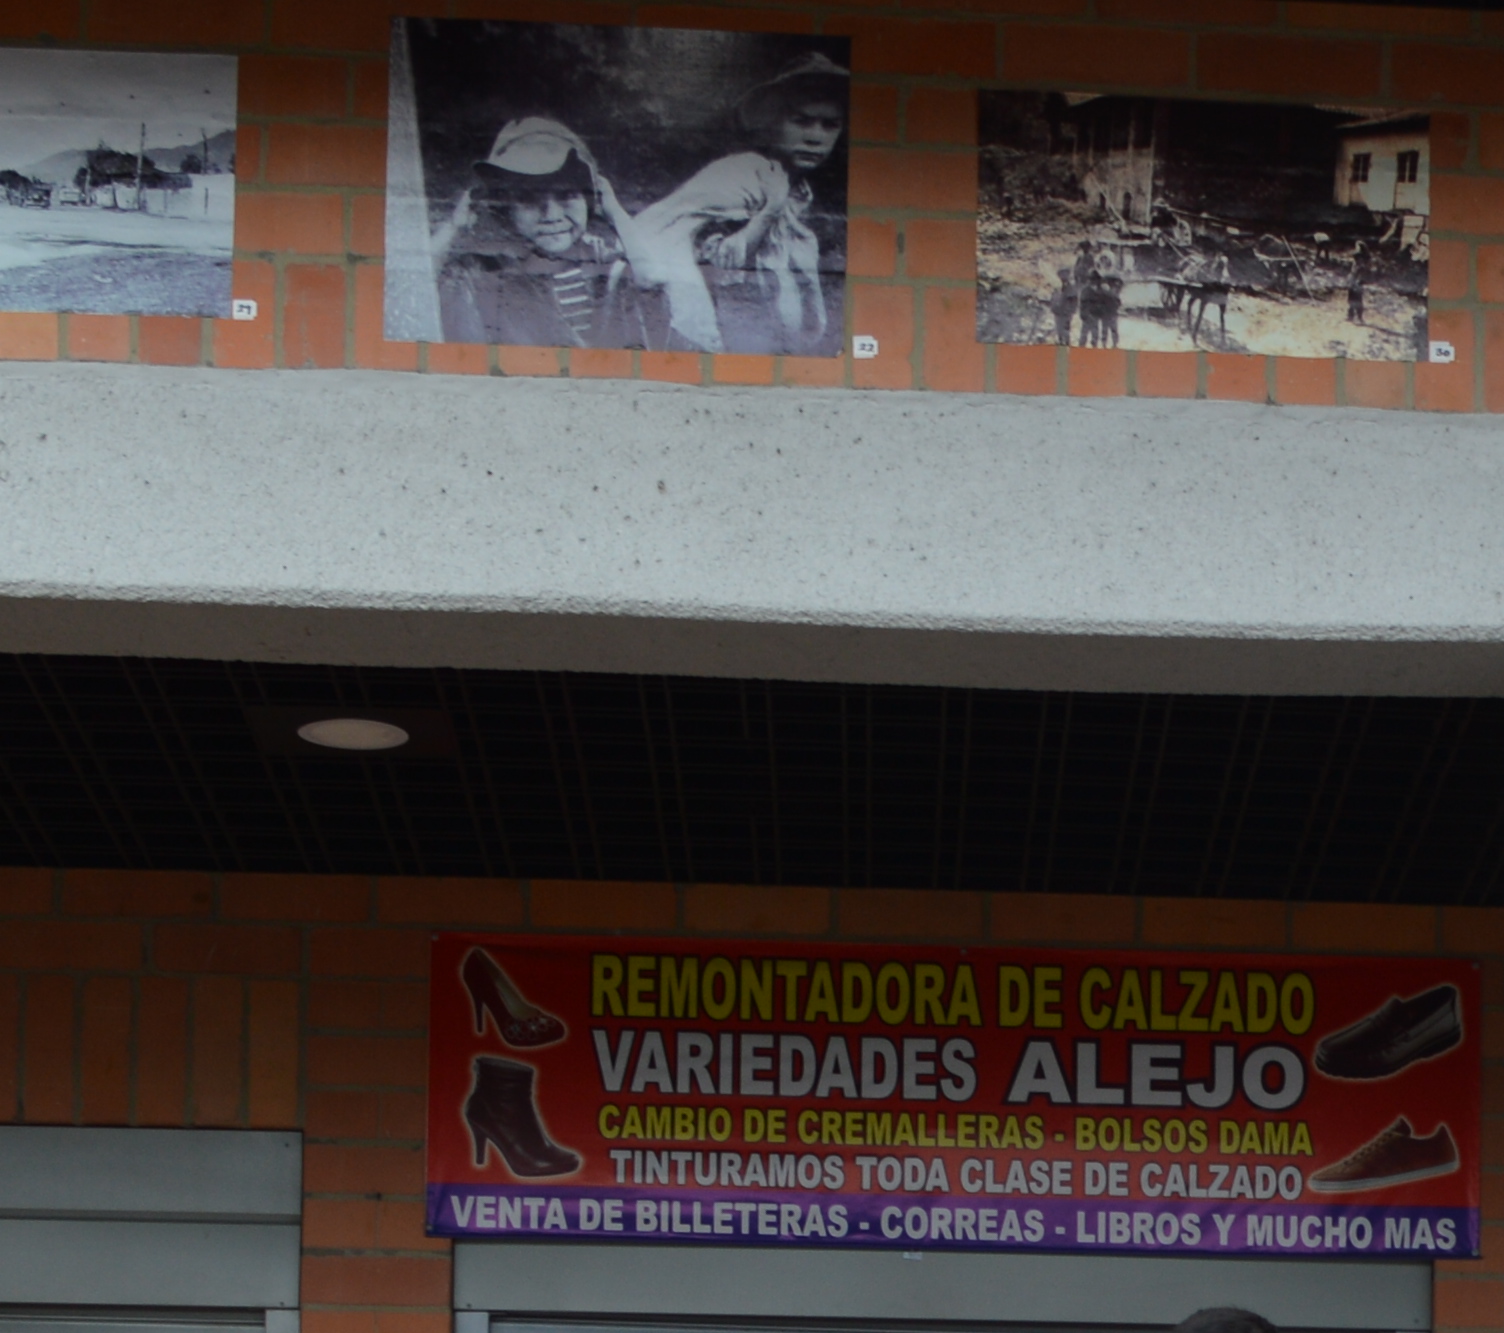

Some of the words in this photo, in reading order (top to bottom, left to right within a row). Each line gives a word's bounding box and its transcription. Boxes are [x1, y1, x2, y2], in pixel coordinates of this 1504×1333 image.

[592, 954, 984, 1027] REMONTADORA
[998, 965, 1064, 1028] DE
[1079, 968, 1316, 1034] CALZADO
[592, 1029, 978, 1102] VARIEDADES
[1006, 1040, 1307, 1109] ALEJO
[599, 1105, 732, 1143] CAMBIO
[745, 1108, 787, 1143] DE
[796, 1110, 1045, 1151] CREMALLERAS
[1076, 1117, 1209, 1153] BOLSOS
[1219, 1121, 1314, 1156] DAMA
[609, 1149, 845, 1189] TINTURAMOS
[857, 1155, 949, 1193] TODA
[960, 1158, 1073, 1196] CLASE
[1084, 1161, 1130, 1198] DE
[1139, 1163, 1304, 1201] CALZADO
[450, 1195, 568, 1233] VENTA
[579, 1199, 625, 1232] DE
[634, 1200, 850, 1238] BILLETERAS
[880, 1206, 1045, 1244] CORREAS
[1076, 1211, 1198, 1247] LIBROS
[1212, 1213, 1237, 1246] Y
[1246, 1213, 1373, 1250] MUCHO
[1384, 1216, 1458, 1251] MAS
